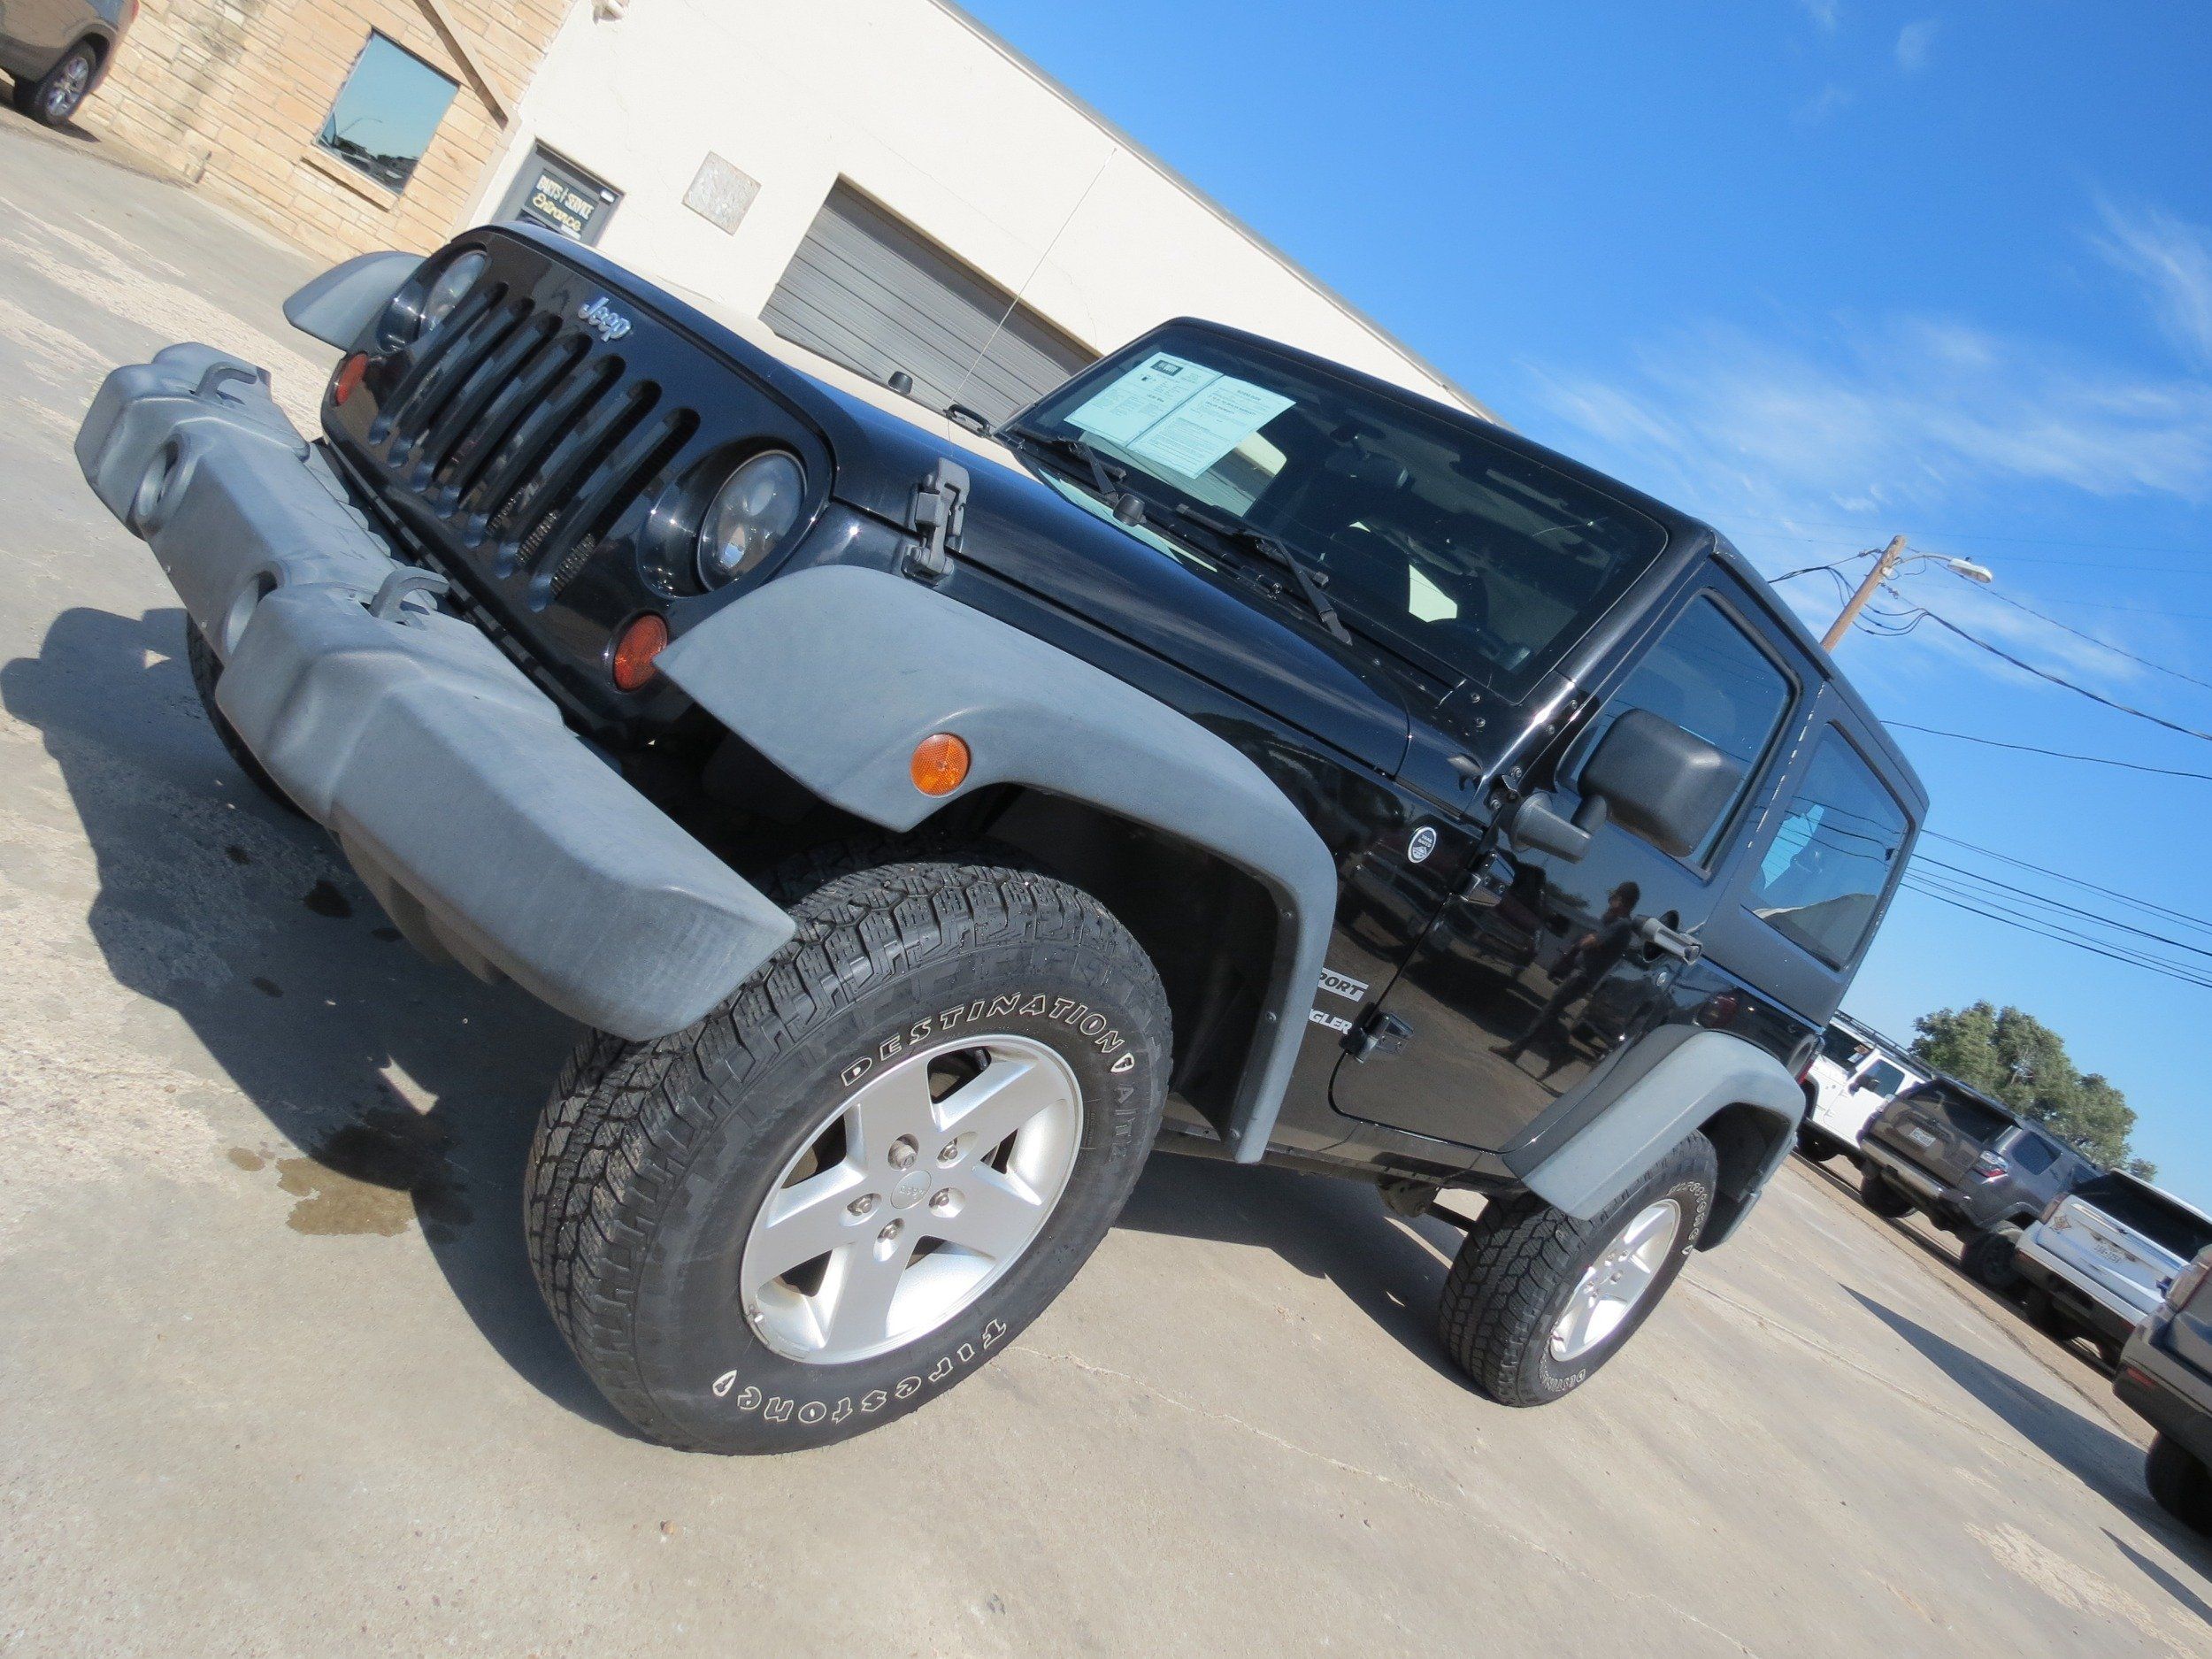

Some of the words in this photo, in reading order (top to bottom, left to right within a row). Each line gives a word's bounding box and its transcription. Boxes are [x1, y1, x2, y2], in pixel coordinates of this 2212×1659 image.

[533, 193, 581, 231] Entrance
[536, 175, 564, 201] PARTS
[565, 193, 595, 220] SERVICE
[578, 297, 631, 342] Jeep
[1319, 972, 1367, 995] PORT
[841, 992, 1125, 1087] DESTINATION
[1309, 1009, 1352, 1034] GLER
